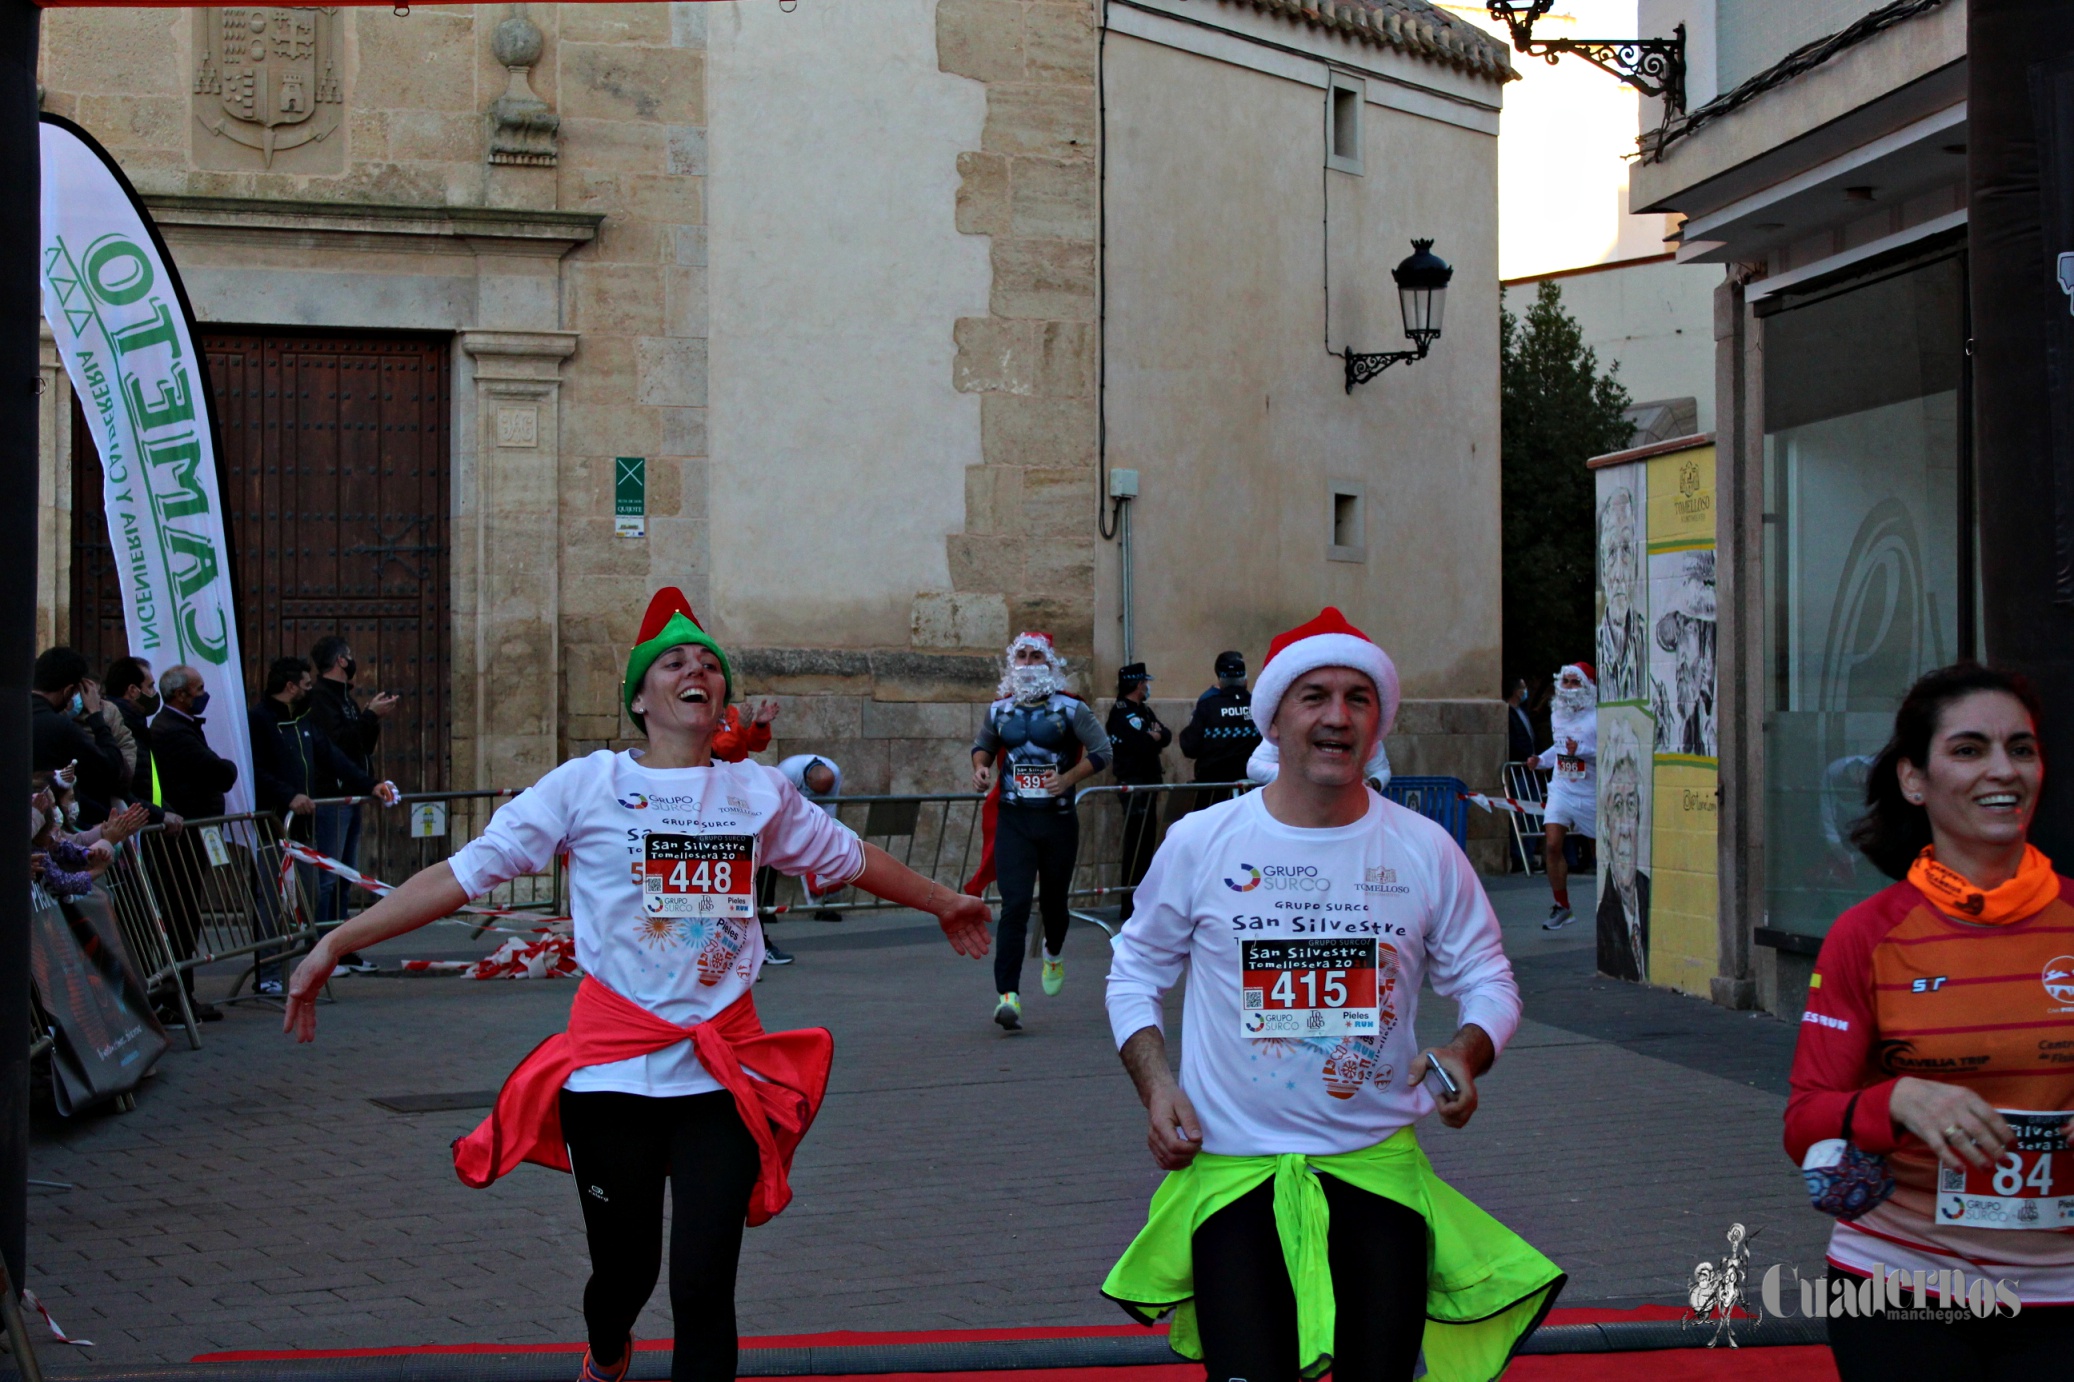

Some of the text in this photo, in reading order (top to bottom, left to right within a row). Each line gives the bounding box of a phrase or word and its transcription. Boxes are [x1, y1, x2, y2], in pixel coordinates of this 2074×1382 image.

[1560, 762, 1578, 771] 396
[649, 794, 693, 804] GRUPO
[650, 801, 703, 813] SURCO
[662, 818, 736, 828] GRUPO SURCO
[652, 841, 746, 851] San Silvestre
[651, 852, 718, 860] Tomellosera
[1263, 866, 1318, 877] GRUPO
[668, 860, 732, 894] 448
[1264, 878, 1331, 892] SURCO
[1354, 883, 1410, 894] TOMELLOSO
[728, 896, 746, 904] Pieles
[664, 904, 693, 912] SURCO
[1275, 901, 1369, 911] GRUPO SURCO
[1232, 915, 1406, 936] San Silvestre
[1250, 947, 1367, 960] San Silvestre
[1248, 960, 1330, 970] Tomellosera
[1270, 970, 1348, 1008] 415
[1266, 1014, 1293, 1022] GRUPO
[1343, 1012, 1370, 1020] Pieles
[1266, 1022, 1300, 1031] SURCO
[1353, 1041, 1376, 1060] RUN
[1992, 1151, 2054, 1197] 84
[1966, 1200, 2001, 1210] GRUPO
[1966, 1210, 2007, 1221] SURCO
